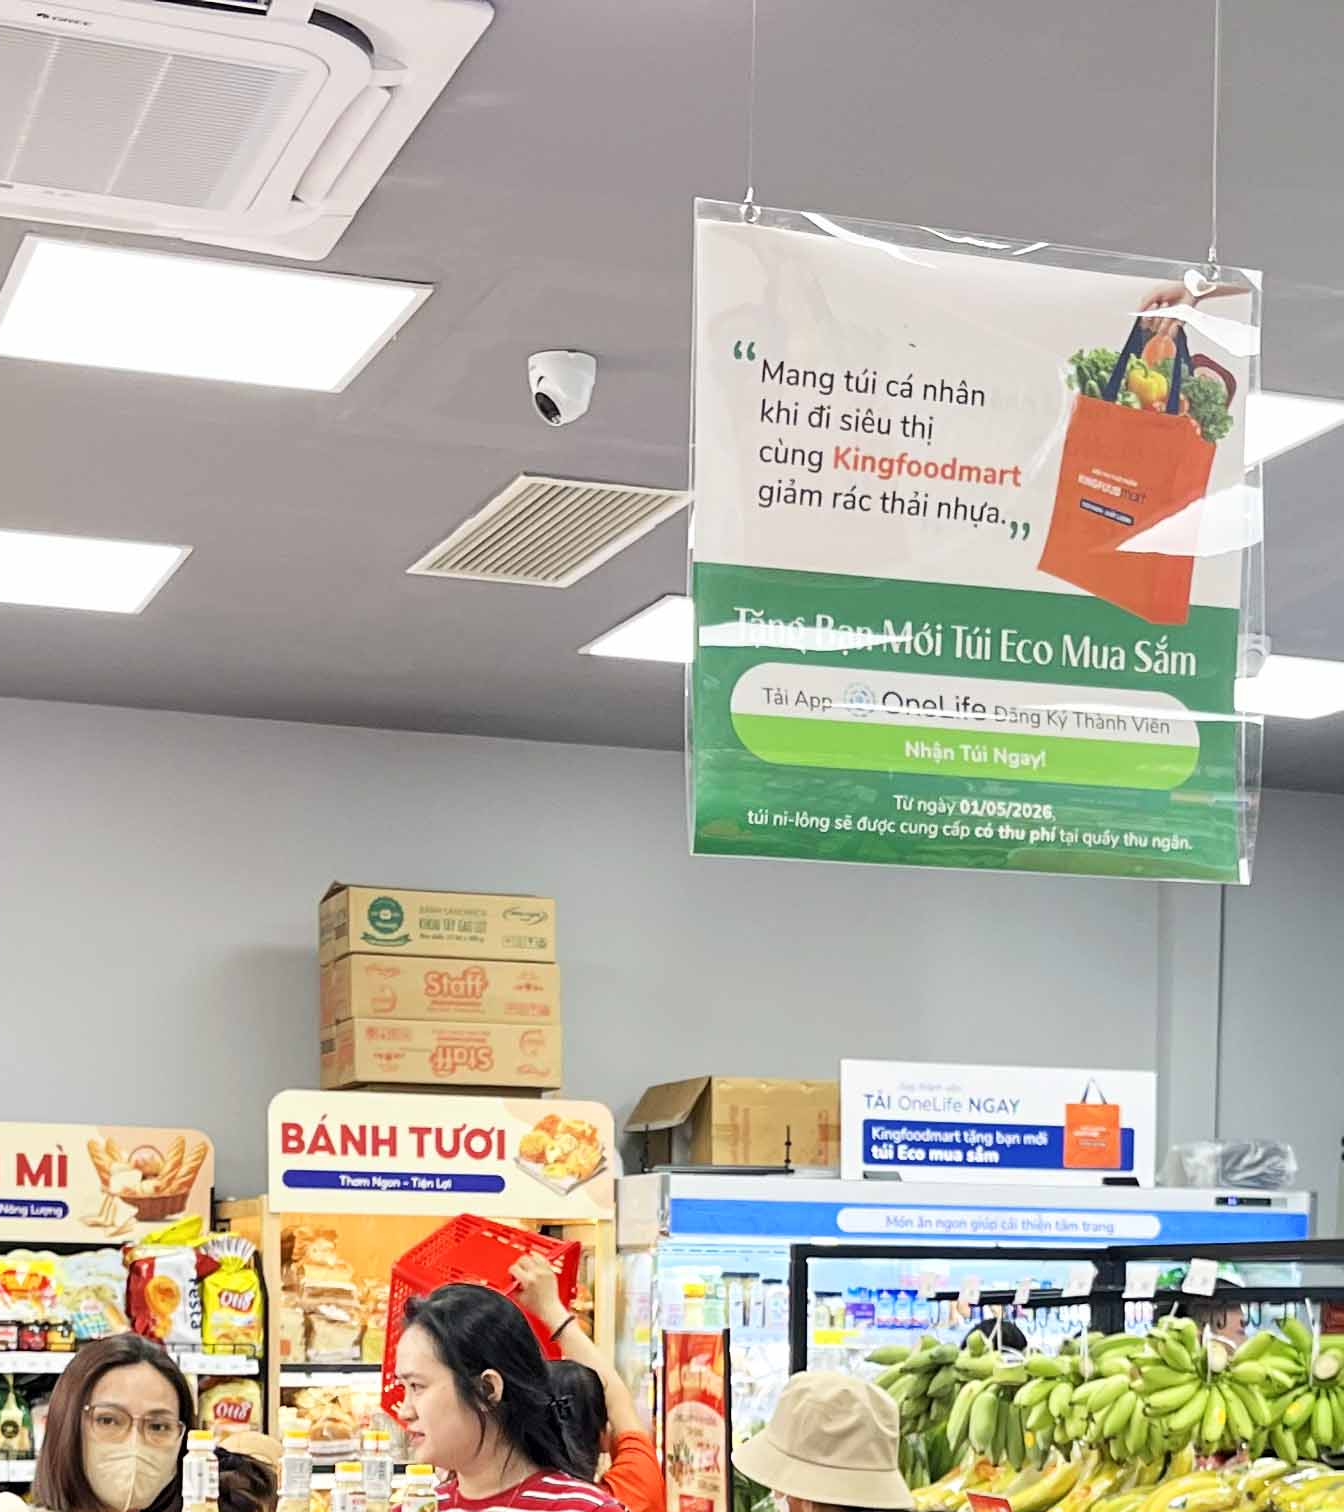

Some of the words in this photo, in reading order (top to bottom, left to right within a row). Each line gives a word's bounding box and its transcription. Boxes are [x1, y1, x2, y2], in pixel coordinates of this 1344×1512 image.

[760, 359, 835, 396] Mang
[843, 367, 878, 395] túi
[885, 374, 914, 399] cá
[922, 379, 986, 407] nhân
[759, 398, 799, 426] khi
[807, 404, 831, 430] đi
[839, 407, 892, 436] siêu
[901, 414, 934, 446] thị
[758, 438, 824, 474] cùng
[832, 445, 1023, 487] Kingfoodmart
[758, 479, 823, 508] giảm
[832, 486, 873, 512] rác
[879, 490, 929, 518] thải
[936, 496, 1007, 528] nhựa.
[881, 618, 943, 657] Mới
[950, 624, 992, 661] Túi
[999, 628, 1054, 666] Eco
[1061, 633, 1126, 671] Mua
[1133, 634, 1197, 677] Sắm
[761, 687, 789, 706] Tải
[794, 690, 833, 713] App
[882, 691, 987, 721] OneLife
[1071, 710, 1127, 733] Thành
[1130, 716, 1171, 735] Viên
[904, 740, 956, 766] Nhận
[959, 743, 989, 766] Túi
[992, 745, 1047, 772] Ngay!
[892, 794, 914, 811] Từ
[916, 798, 957, 816] ngày
[747, 808, 769, 825] túi
[773, 811, 830, 833] ni-lông
[834, 814, 853, 831] sẽ
[856, 815, 896, 836] được
[899, 822, 939, 839] cung
[942, 819, 971, 840] cấp
[974, 820, 994, 840] có
[998, 824, 1026, 841] thu
[1029, 826, 1057, 845] phí
[1058, 828, 1079, 846] tại
[1123, 831, 1148, 848] thu
[1151, 834, 1193, 853] ngân.
[425, 966, 489, 999] Staff
[429, 1045, 494, 1078] Staff
[863, 1090, 892, 1110] TẢI
[897, 1095, 964, 1113] OneLife
[967, 1097, 1021, 1114] NGAY
[280, 1114, 397, 1158] BÁNH
[408, 1121, 507, 1163] TƯƠI
[870, 1126, 962, 1145] Kingfoodmart
[963, 1127, 994, 1146] tặng
[996, 1128, 1021, 1147] bạn
[1022, 1128, 1049, 1147] mới
[870, 1143, 894, 1161] túi
[897, 1146, 926, 1161] Eco
[928, 1148, 964, 1162] mua
[965, 1144, 1000, 1163] sắm
[15, 1145, 69, 1188] MÌ
